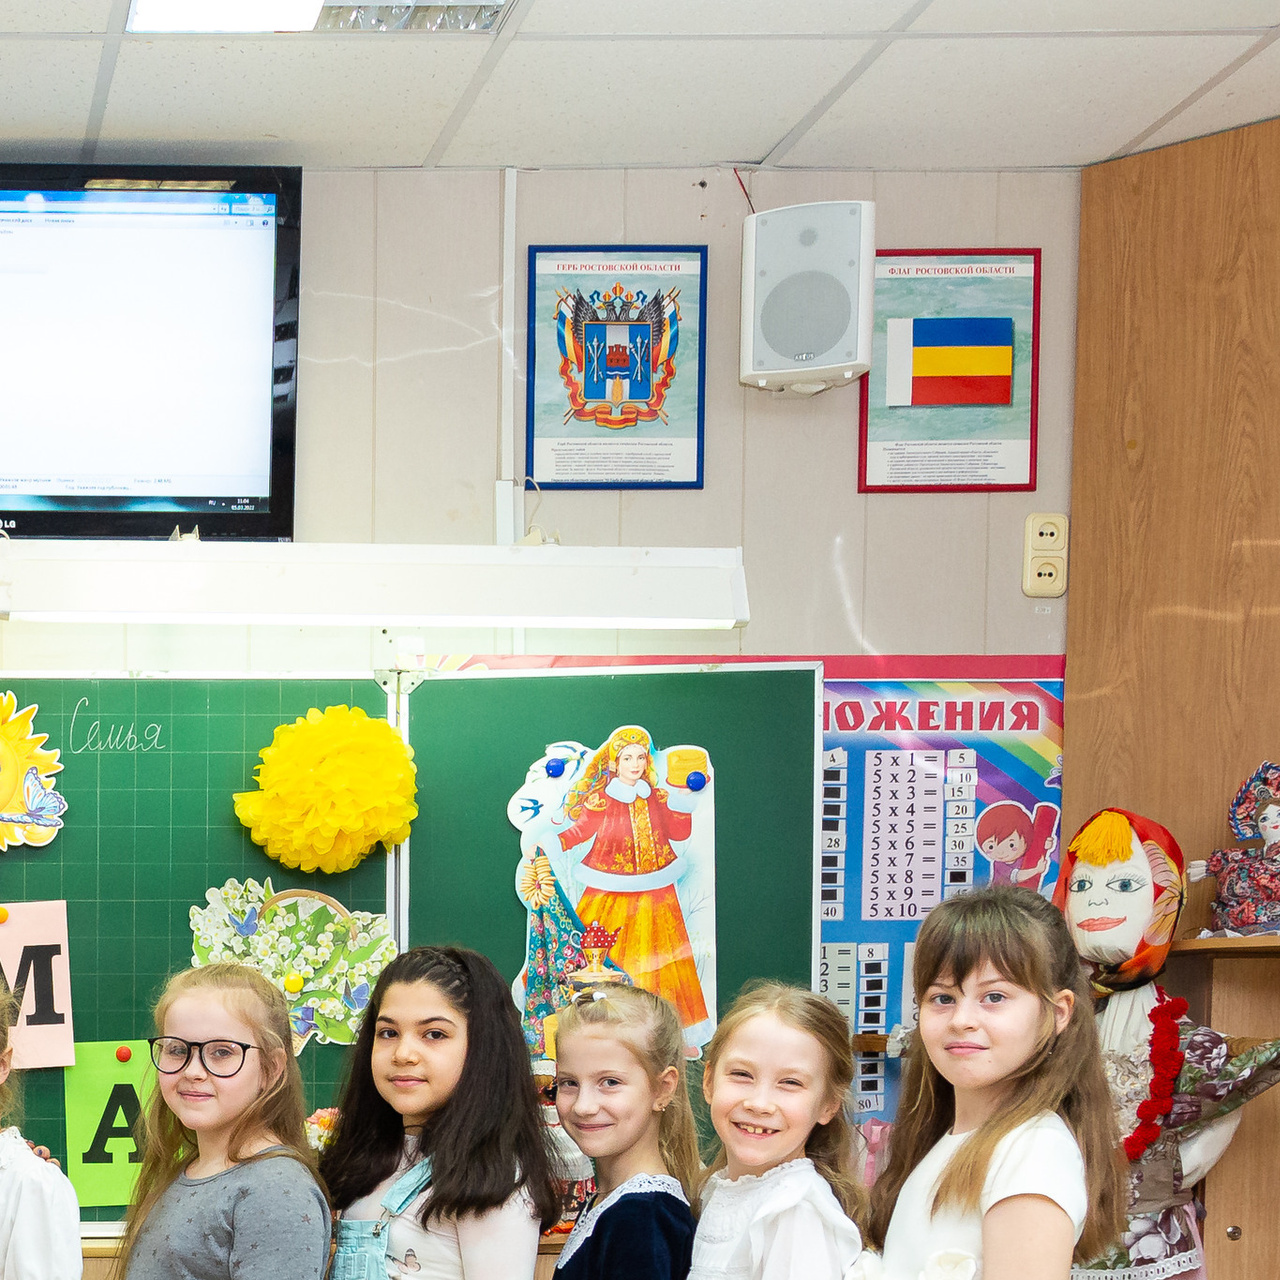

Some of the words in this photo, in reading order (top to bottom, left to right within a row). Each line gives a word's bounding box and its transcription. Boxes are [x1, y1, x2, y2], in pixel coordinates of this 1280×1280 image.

[556, 263, 578, 271] ГЕРБ
[579, 262, 638, 271] РОСТОВСКОЙ
[639, 263, 681, 271] ОБЛАСТИ
[888, 267, 912, 275] ФЛАГ
[915, 265, 974, 275] РОСТОВСКОЙ
[975, 266, 1015, 274] ОБЛАСТИ
[4, 520, 16, 528] LG
[823, 701, 1040, 731] ОЖЕНИЯ
[69, 697, 166, 754] Семья
[829, 753, 836, 763] 4
[873, 752, 882, 767] 5
[910, 752, 915, 767] 1
[958, 753, 966, 764] 5
[873, 769, 882, 784] 5
[907, 769, 917, 784] 2
[959, 773, 972, 783] 10
[873, 785, 882, 800] 5
[907, 785, 916, 800] 3
[951, 787, 964, 797] 15
[872, 802, 881, 817] 5
[905, 802, 916, 817] 4
[954, 804, 968, 815] 20
[872, 819, 881, 834] 5
[905, 819, 915, 834] 5
[954, 823, 967, 834] 25
[826, 837, 841, 848] 28
[872, 836, 881, 851] 5
[905, 836, 915, 851] 6
[951, 840, 964, 850] 30
[871, 852, 880, 867] 5
[905, 852, 914, 867] 7
[953, 857, 967, 867] 35
[871, 869, 880, 884] 5
[904, 869, 914, 884] 8
[871, 886, 880, 901] 5
[904, 886, 914, 901] 9
[823, 907, 837, 917] 40
[870, 903, 879, 918] 5
[899, 903, 917, 918] 10
[867, 948, 874, 958] 8
[820, 963, 829, 976] 2
[820, 979, 829, 993] 3
[858, 1100, 872, 1110] 80
[82, 1084, 144, 1163] А
